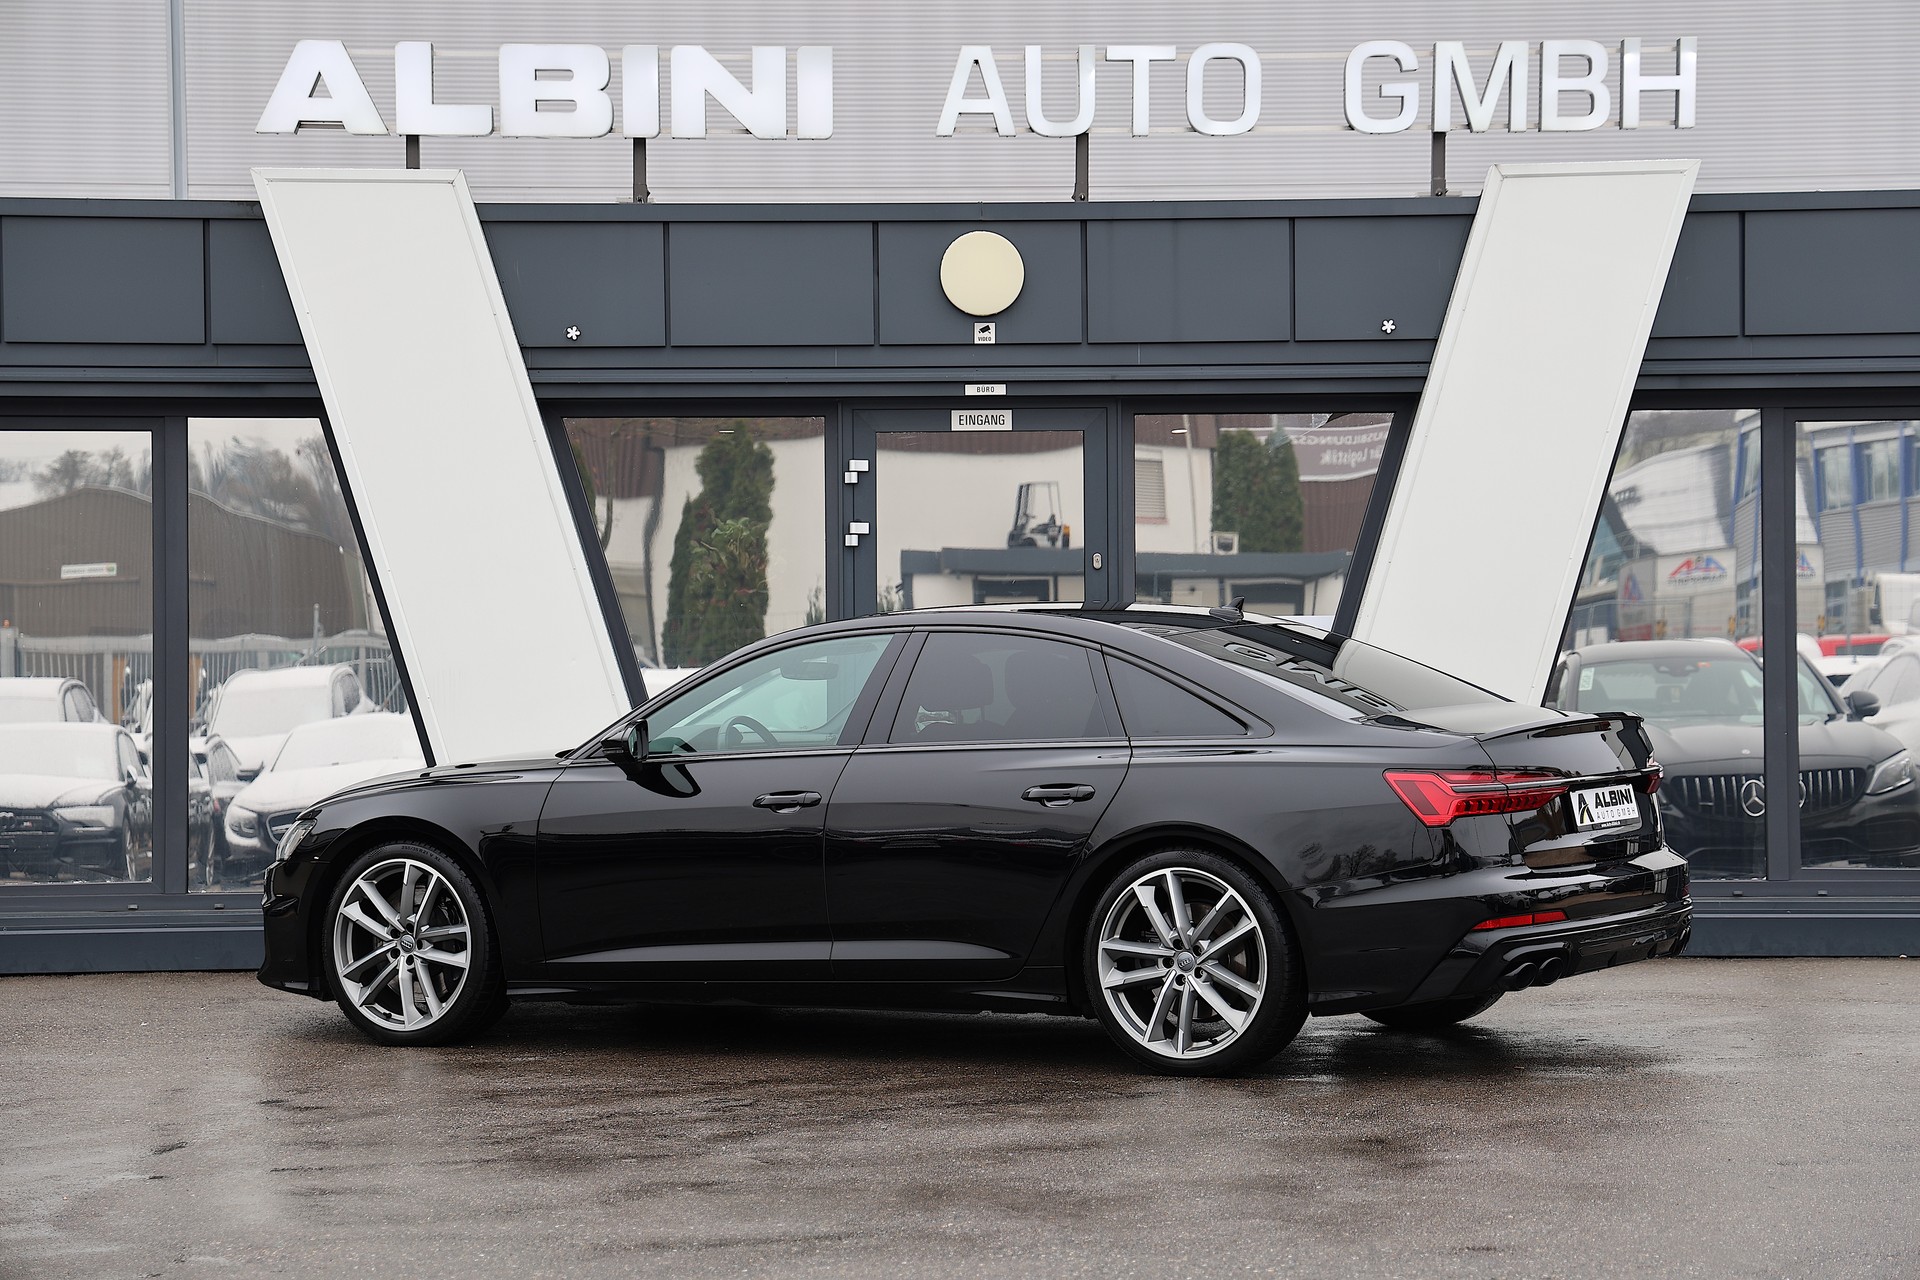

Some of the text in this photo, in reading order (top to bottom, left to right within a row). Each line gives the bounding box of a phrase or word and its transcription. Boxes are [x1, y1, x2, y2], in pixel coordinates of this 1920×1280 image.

[255, 36, 1698, 140] ALBINI AUTO GMBH
[976, 385, 995, 393] BÜRO
[958, 414, 1005, 426] EINGANG
[1595, 788, 1633, 809] ALBINI
[1596, 807, 1637, 820] AUTO GMBH
